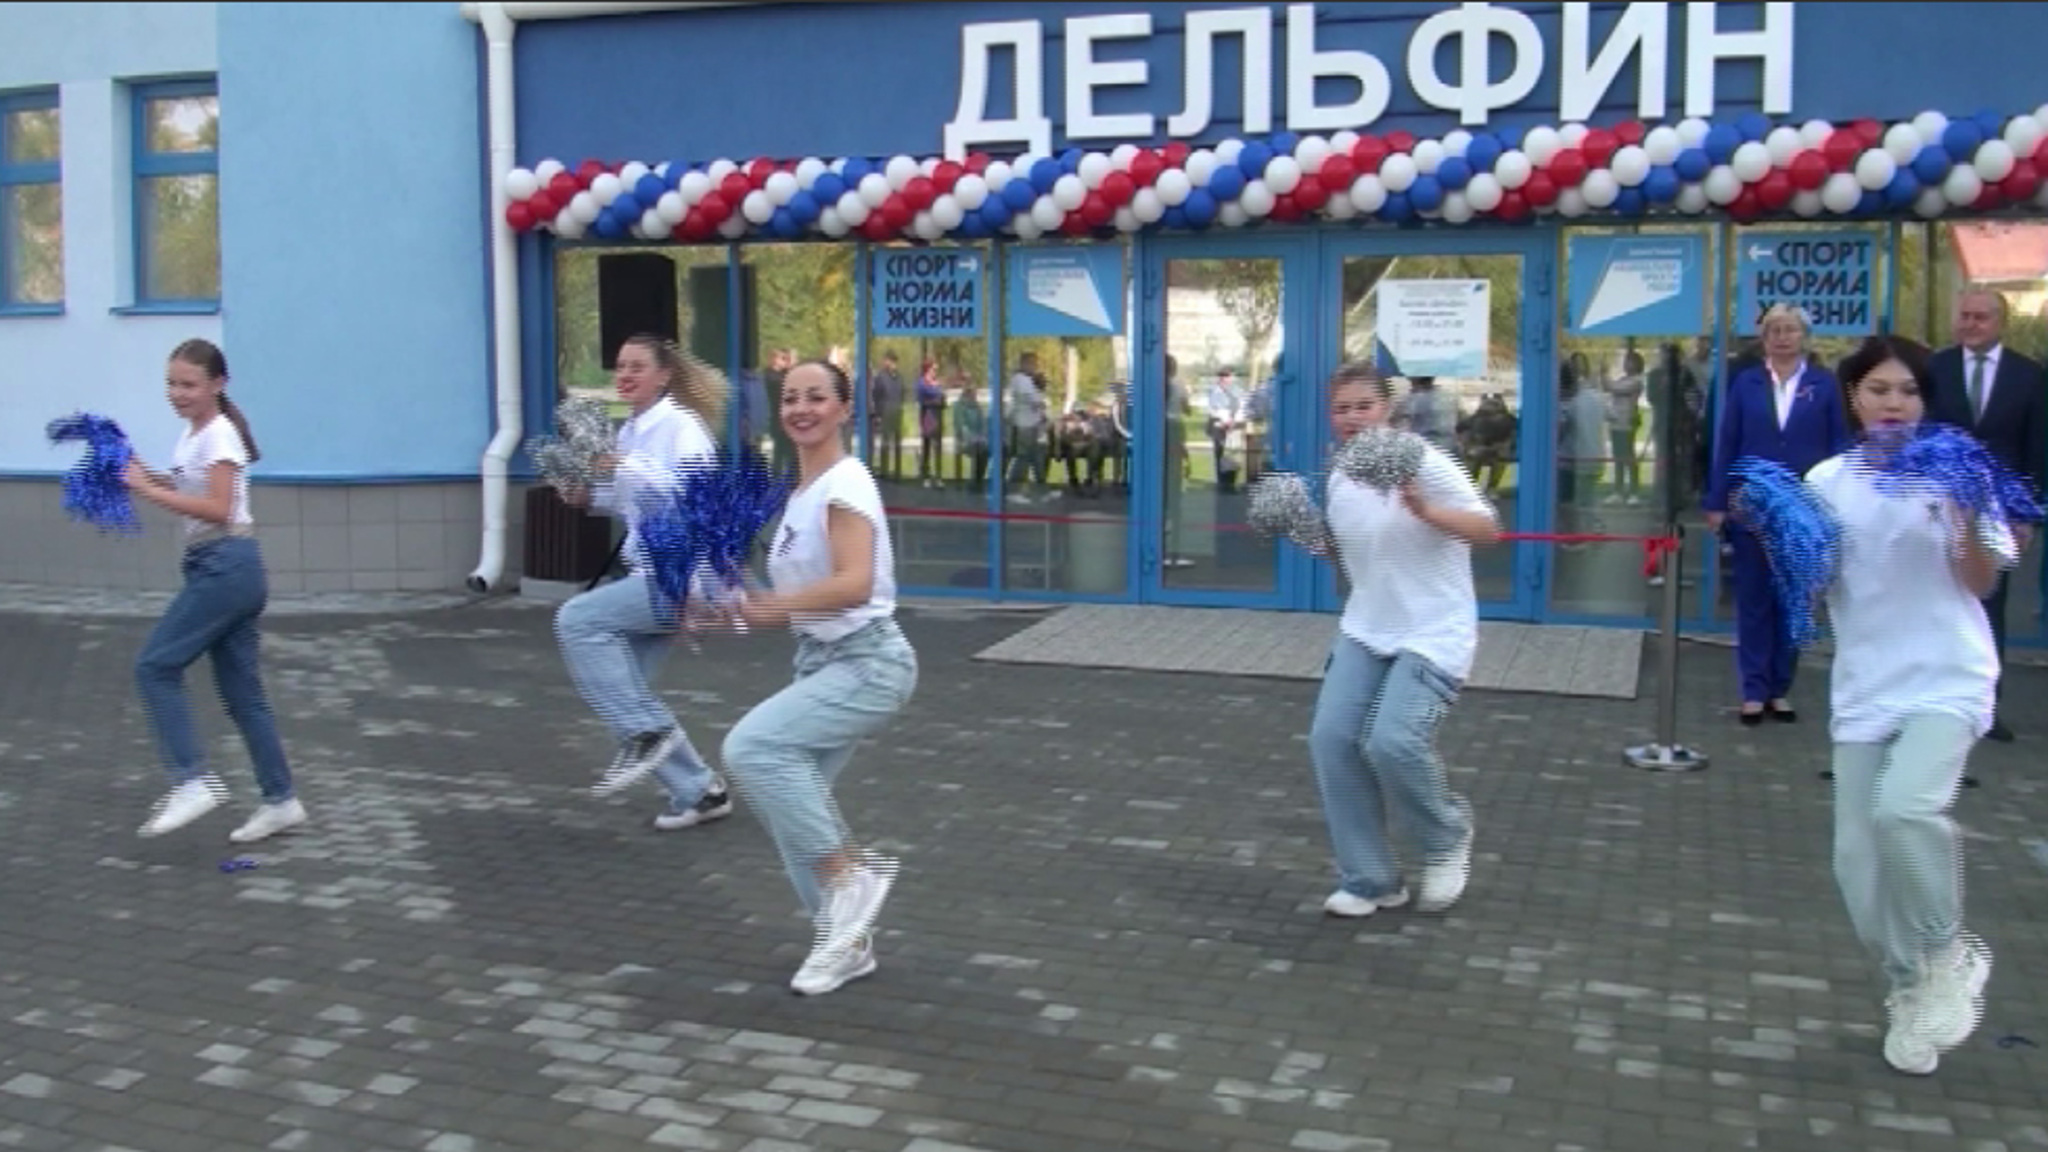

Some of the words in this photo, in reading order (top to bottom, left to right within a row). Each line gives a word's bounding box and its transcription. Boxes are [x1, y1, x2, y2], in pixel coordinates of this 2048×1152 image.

[943, 2, 1796, 164] ДЕЛЬФИН
[885, 254, 959, 277] СПОРТ
[1776, 241, 1870, 267] СПОРТ
[885, 281, 975, 304] НОРМА
[1756, 269, 1869, 296] НОРМА
[885, 306, 975, 329] ЖИЗНИ
[1755, 299, 1868, 325] ЗНИ
